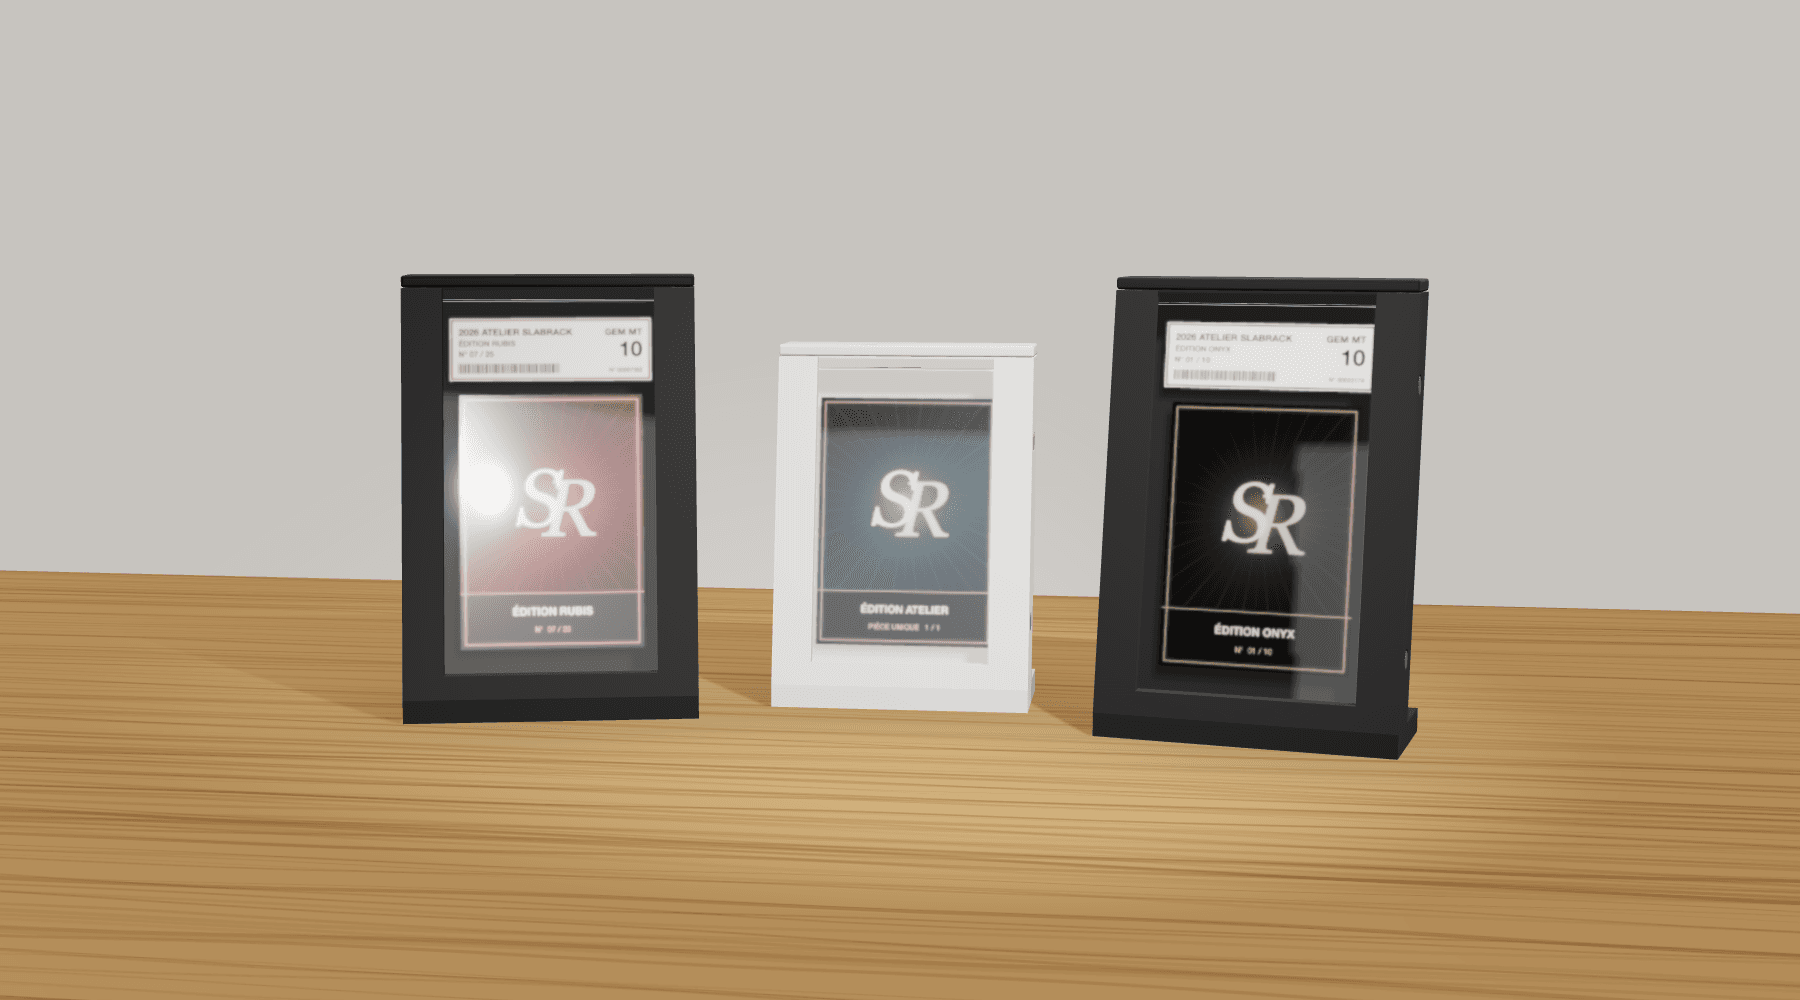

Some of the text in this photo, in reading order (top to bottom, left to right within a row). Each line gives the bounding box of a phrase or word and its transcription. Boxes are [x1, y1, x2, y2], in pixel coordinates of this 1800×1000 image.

[459, 327, 573, 337] 2026 ATELIER SLABRACK
[605, 327, 643, 336] GEM MT
[1176, 332, 1293, 343] 2026 ATELIER SLABRACK
[492, 340, 516, 348] RUBIS
[1326, 335, 1367, 344] GEM MT
[620, 341, 643, 356] 10
[1208, 345, 1231, 353] ONYX
[1342, 349, 1366, 366] 10
[515, 467, 597, 537] SR
[871, 469, 950, 538] SR
[1221, 480, 1306, 556] SR
[512, 603, 595, 618] ÉDITION RUBIS
[860, 601, 950, 616] ÉDITION ATELIER
[891, 622, 920, 633] UNIQUE
[1213, 621, 1296, 640] ÉDITION ONYX
